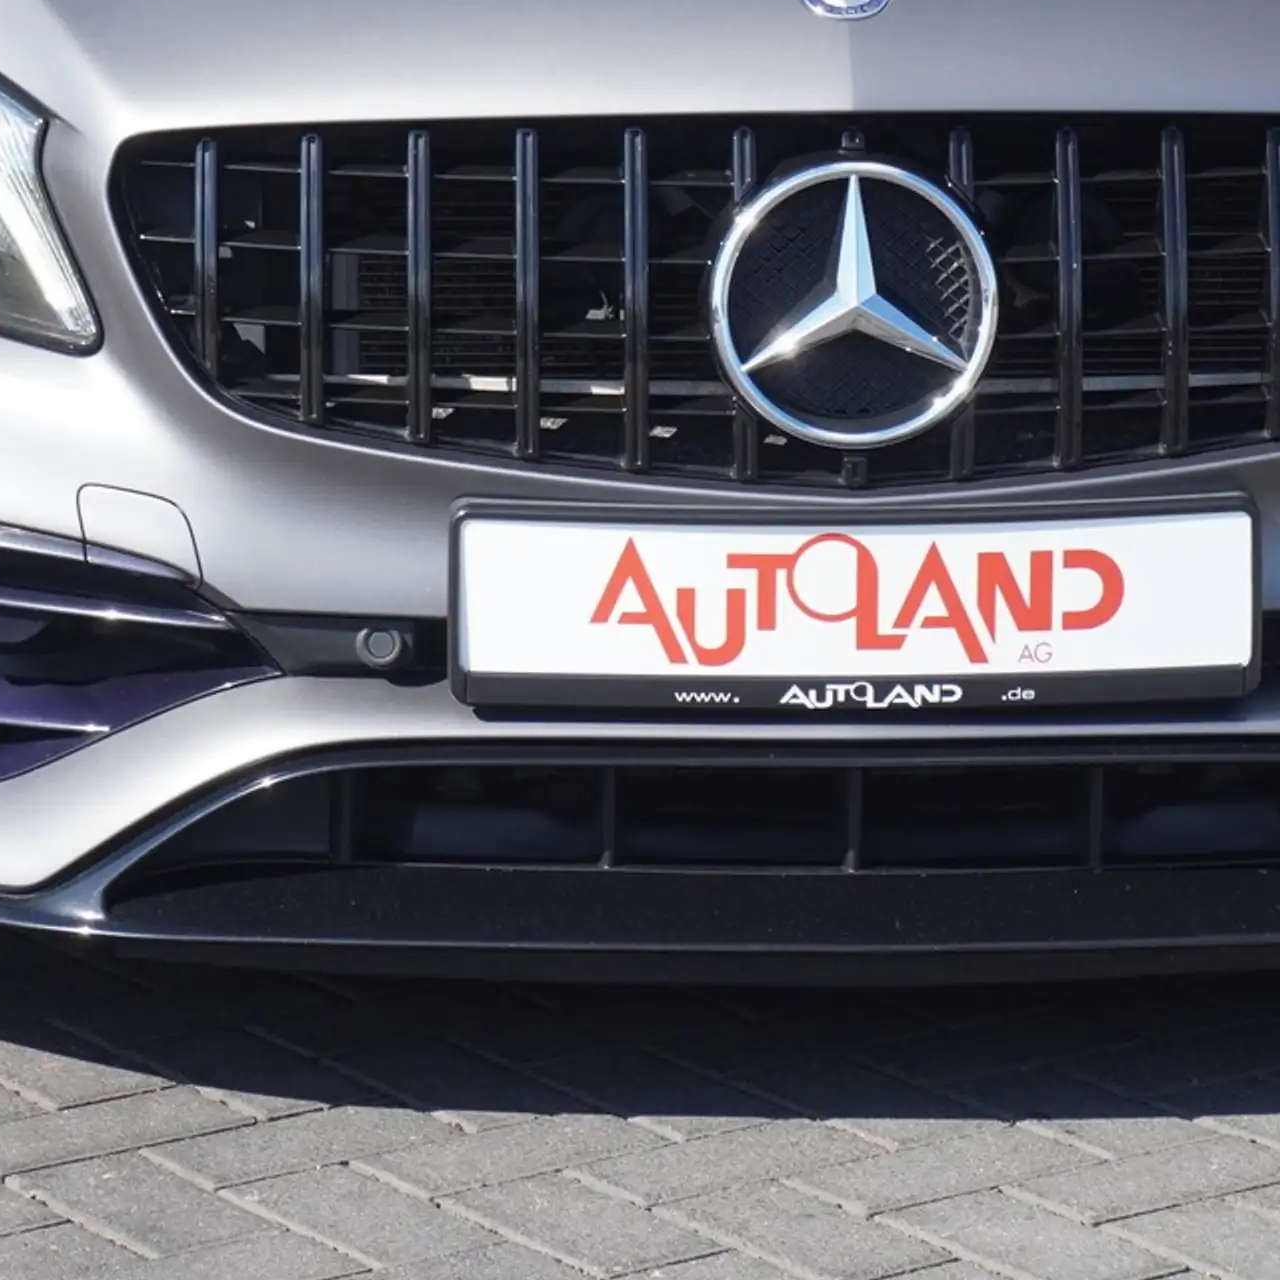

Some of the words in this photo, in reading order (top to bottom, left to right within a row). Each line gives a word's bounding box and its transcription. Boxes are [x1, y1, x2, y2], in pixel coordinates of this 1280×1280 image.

[589, 533, 1124, 666] AUTOLAND
[1017, 640, 1053, 664] AG
[673, 690, 741, 704] www.
[779, 680, 963, 710] AUTOLAND
[1001, 685, 1036, 701] .de
